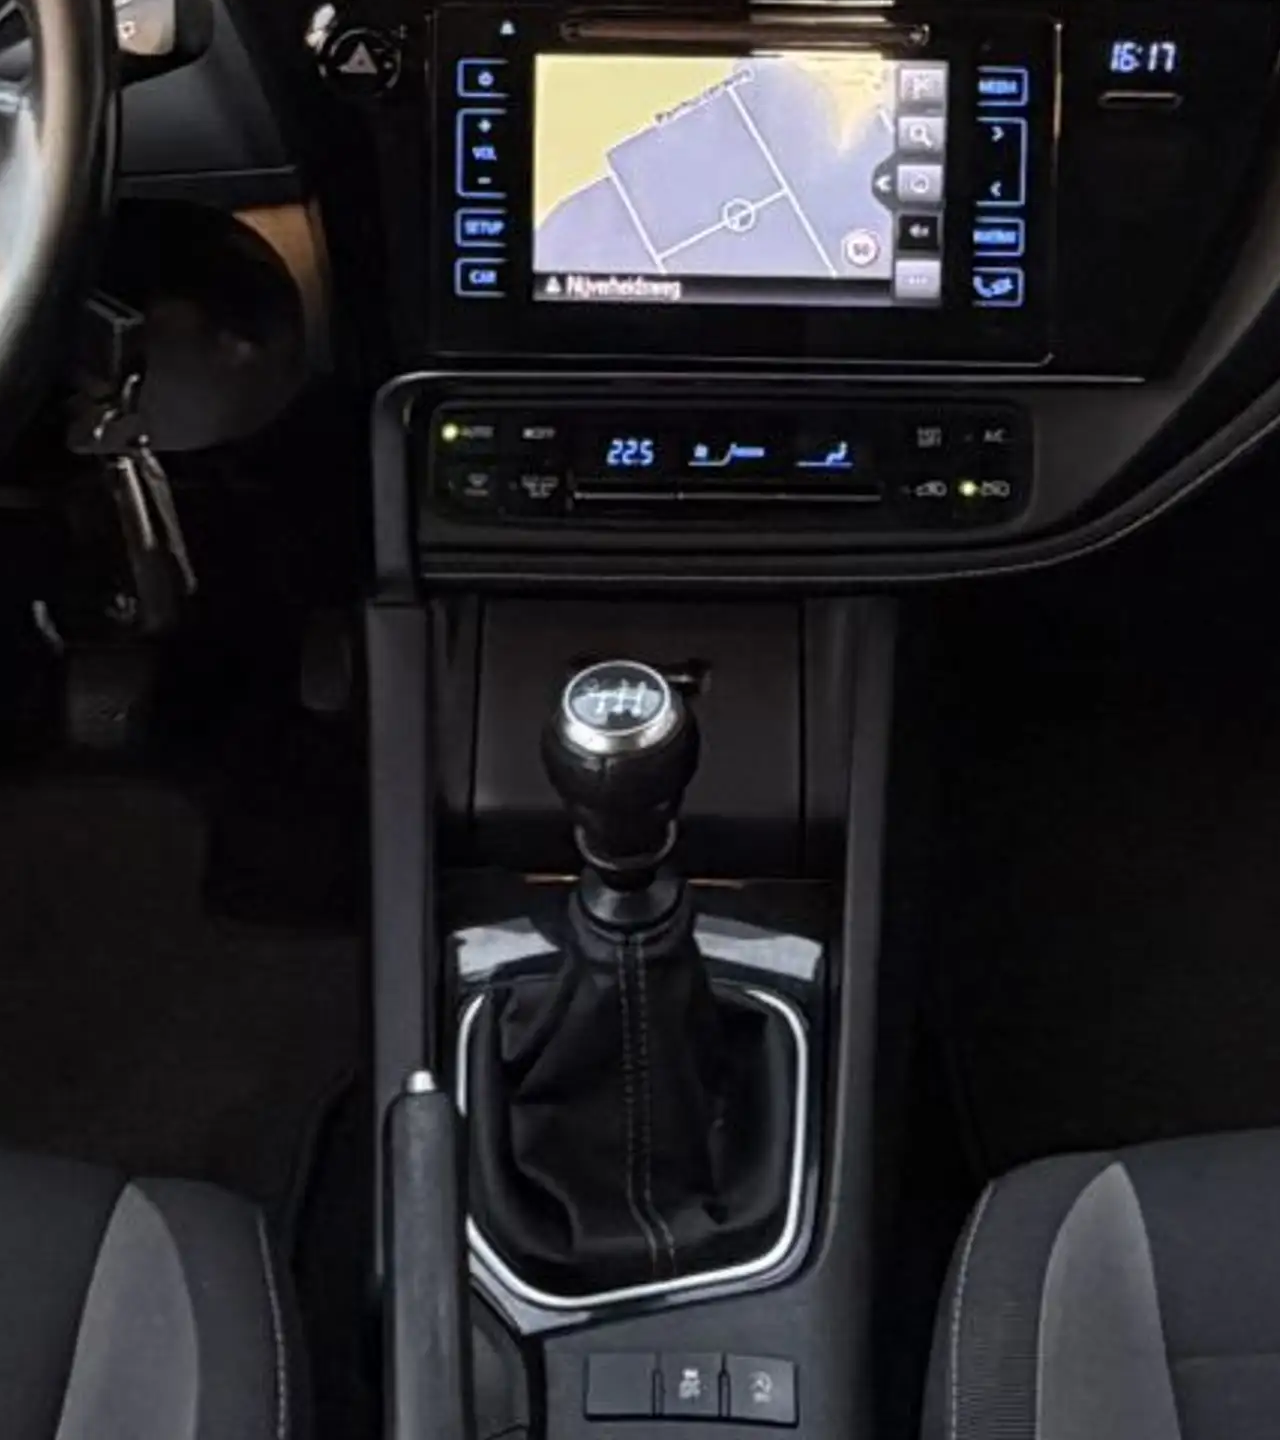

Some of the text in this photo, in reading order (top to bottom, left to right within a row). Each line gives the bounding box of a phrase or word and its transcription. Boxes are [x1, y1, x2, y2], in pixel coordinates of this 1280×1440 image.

[1110, 42, 1177, 72] 16:17
[472, 146, 497, 160] VOL
[464, 219, 505, 235] SETUP
[468, 269, 497, 285] CAR
